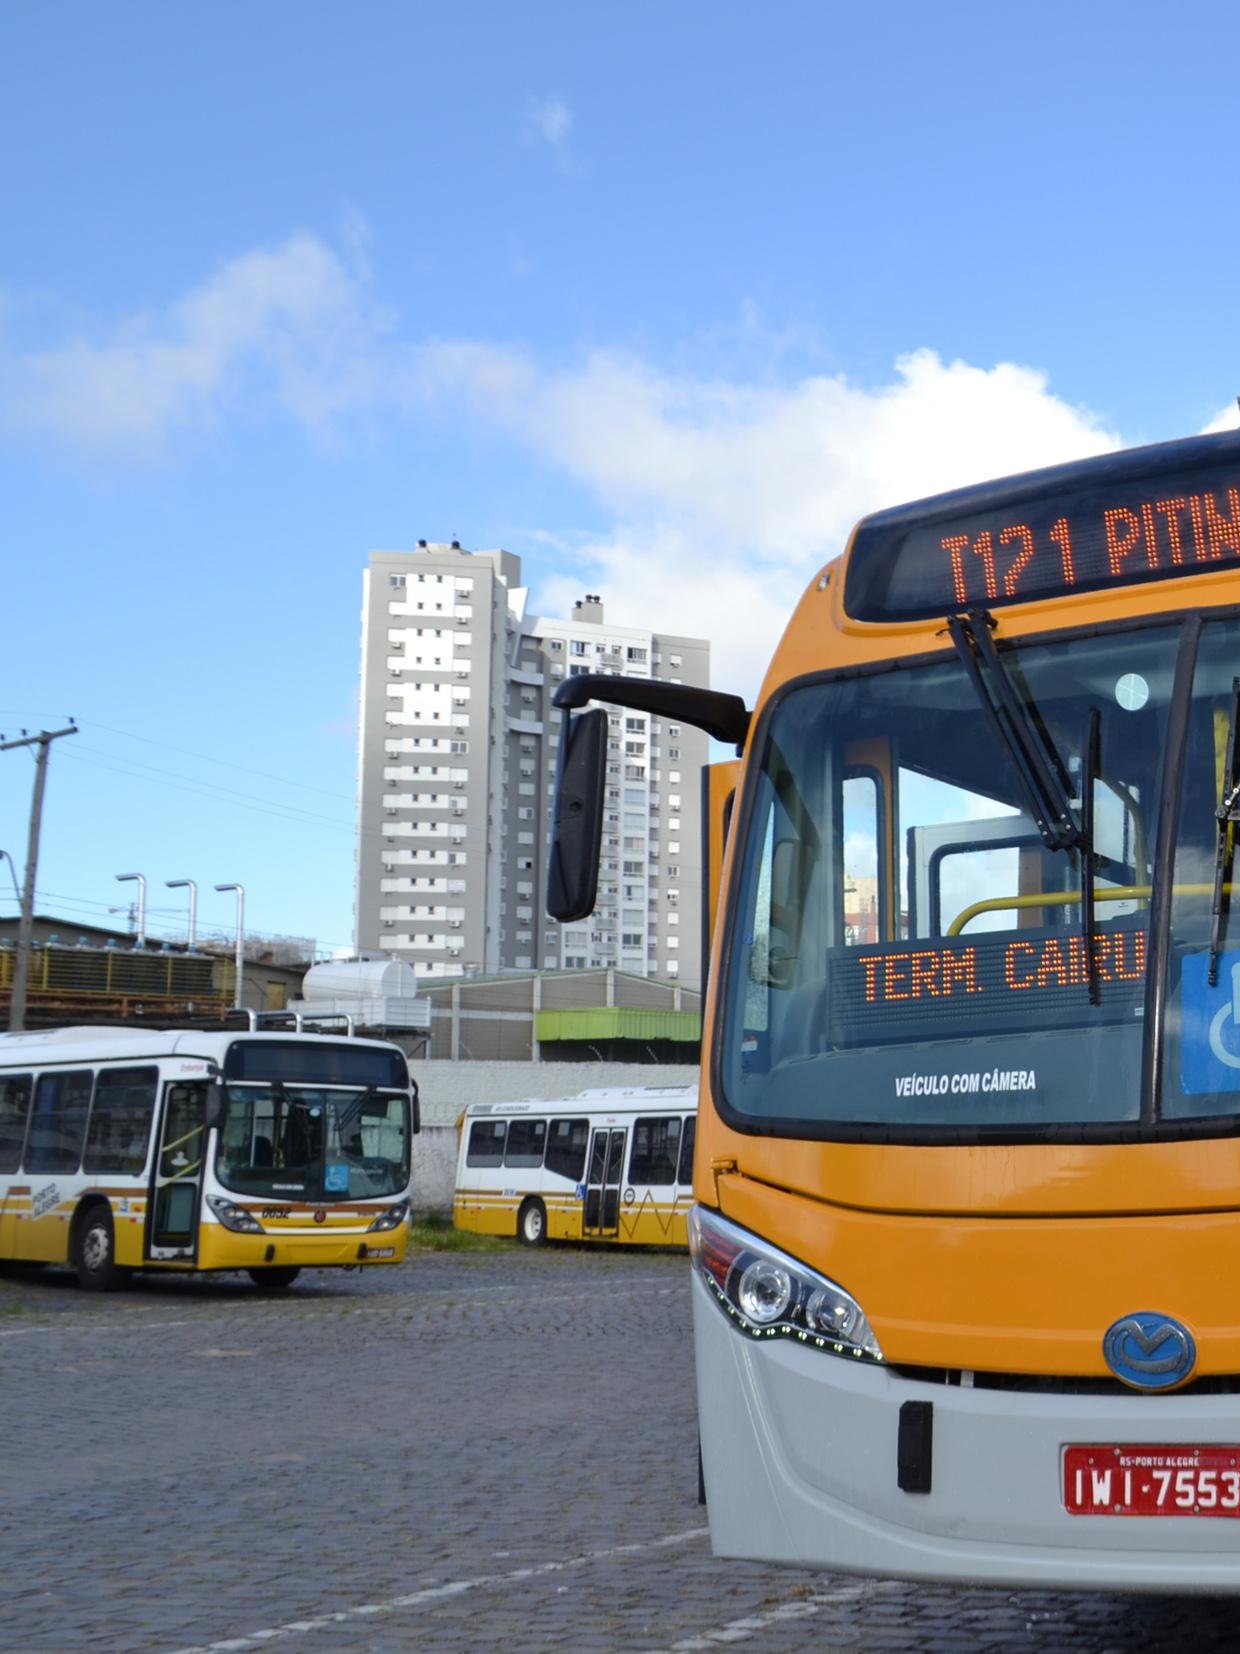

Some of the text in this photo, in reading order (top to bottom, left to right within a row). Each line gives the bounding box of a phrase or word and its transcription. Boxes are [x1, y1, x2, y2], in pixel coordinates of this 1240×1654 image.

[858, 930, 1146, 1002] TERM. CAIRU
[895, 1067, 1036, 1097] VEÍCULO COM CÂMERA
[1165, 1456, 1199, 1467] ALEGRE
